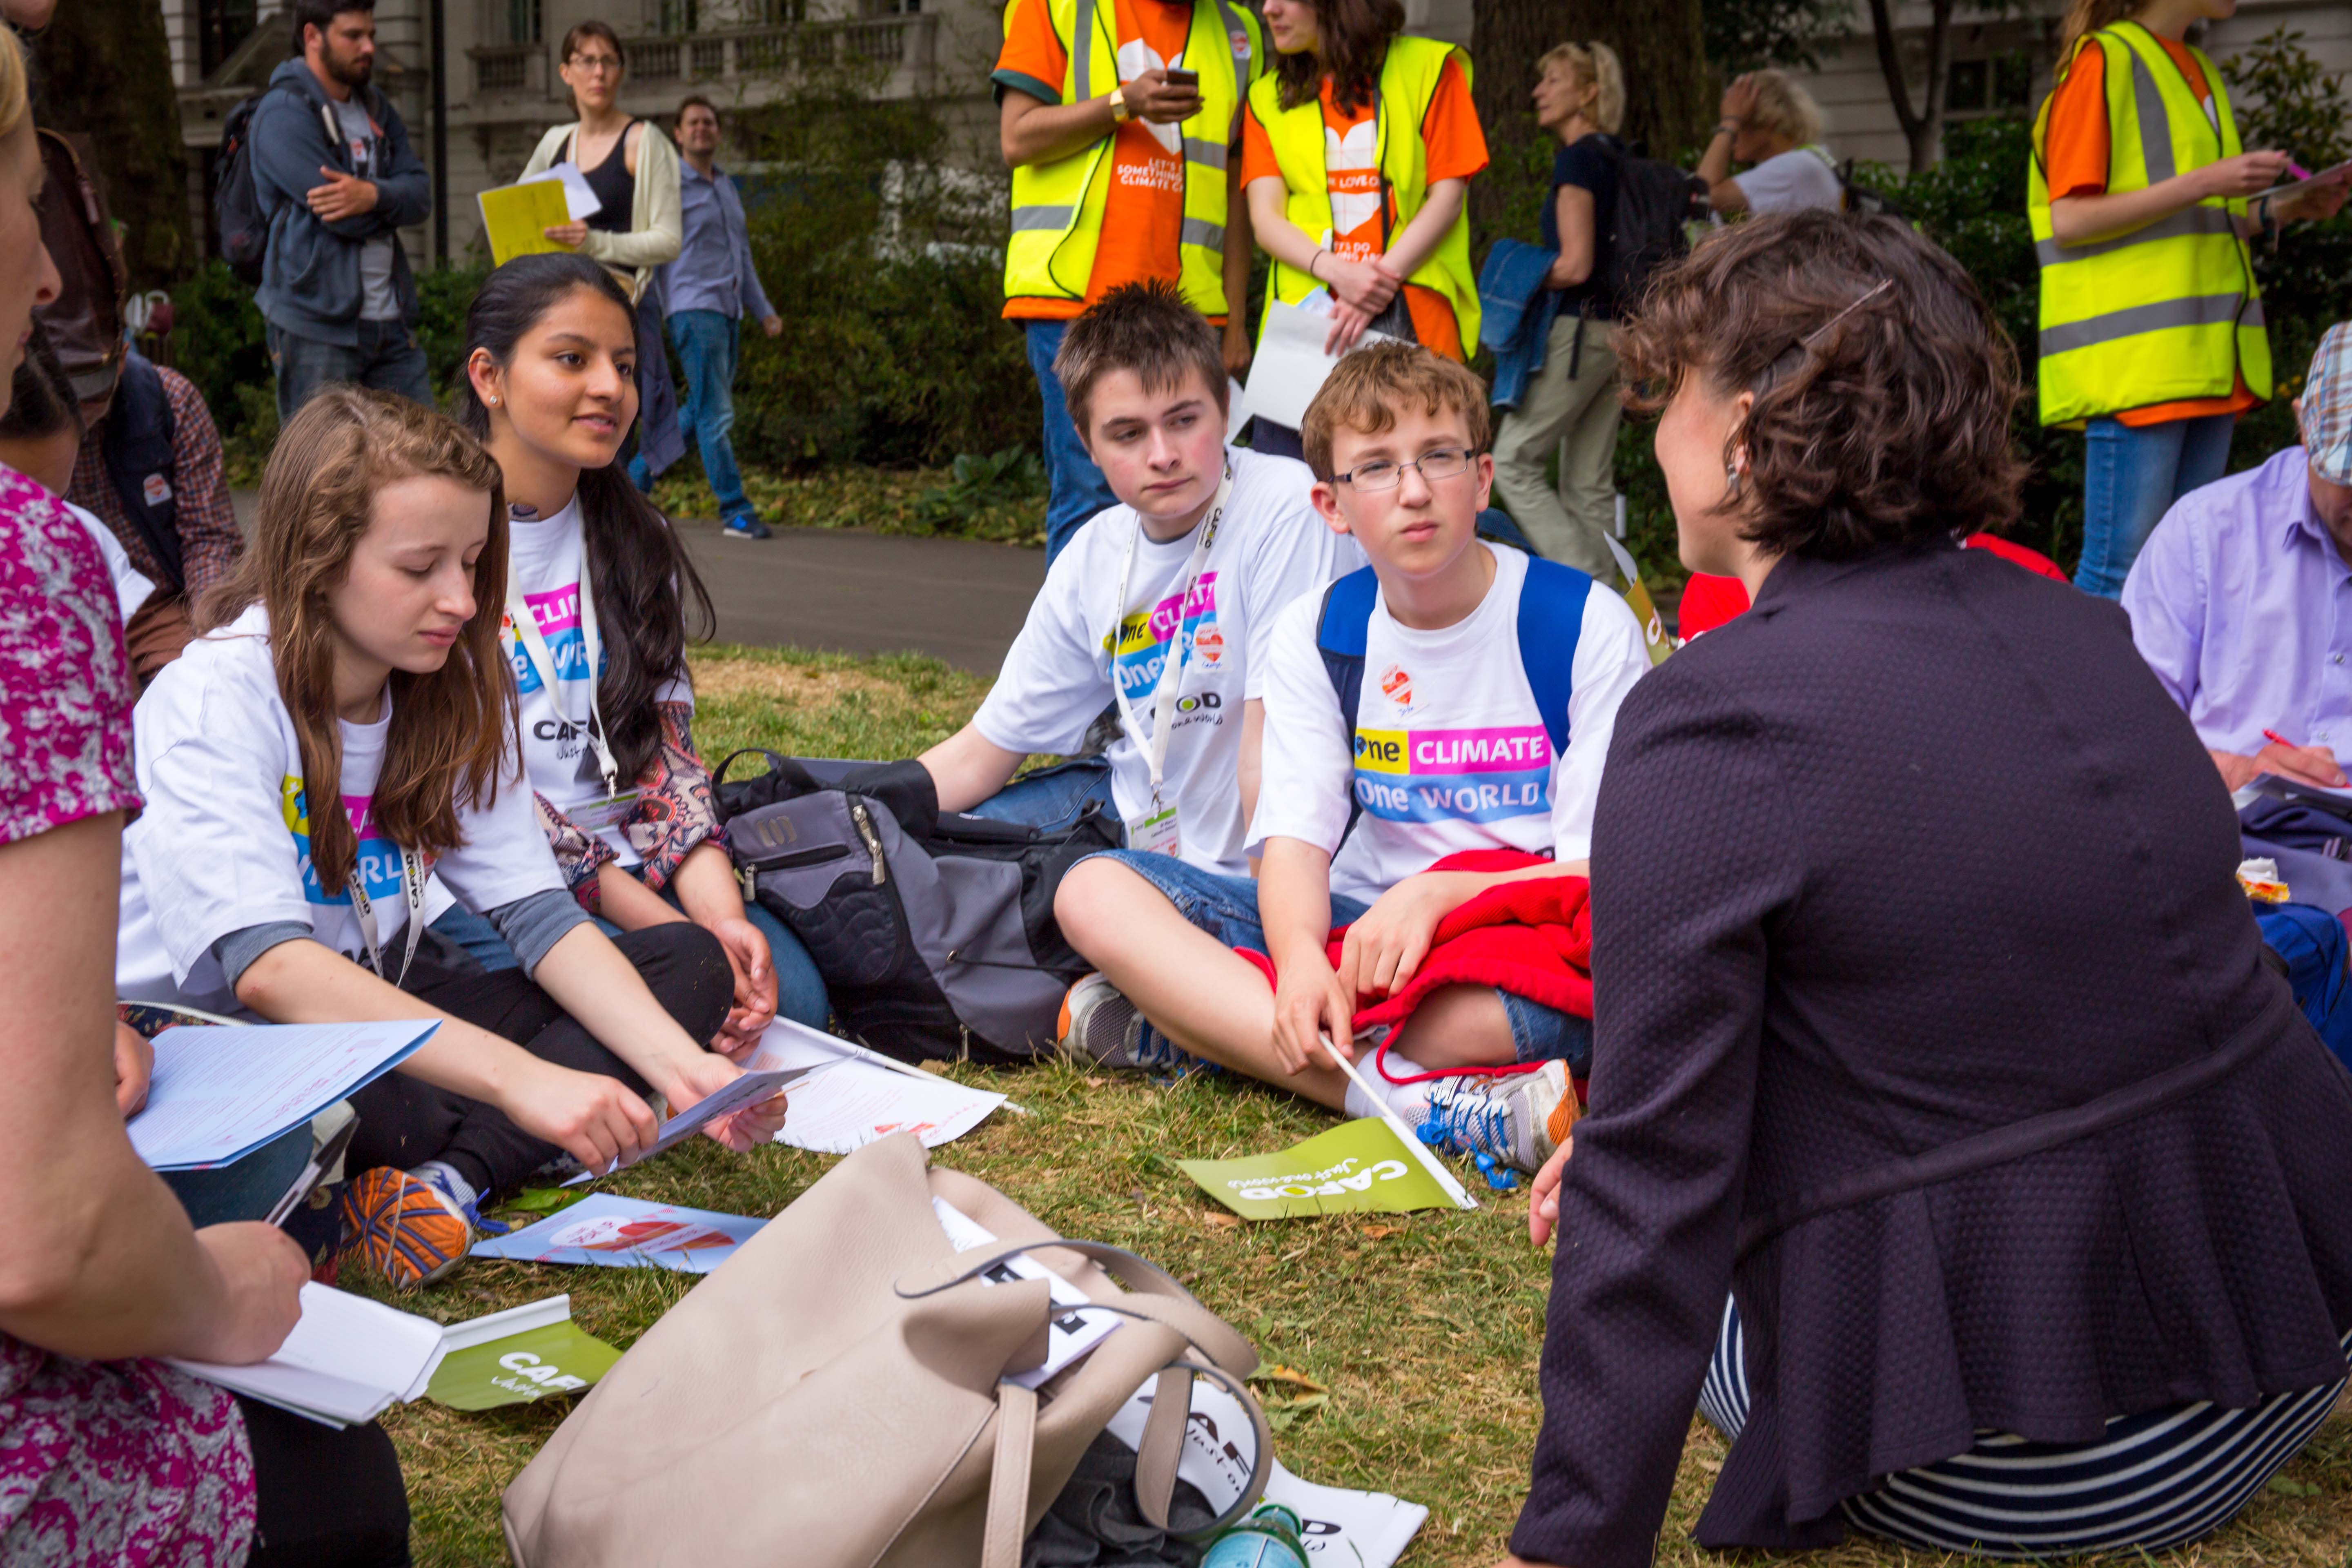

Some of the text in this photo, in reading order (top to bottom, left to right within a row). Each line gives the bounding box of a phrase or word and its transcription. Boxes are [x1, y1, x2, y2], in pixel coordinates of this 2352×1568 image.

[1416, 735, 1544, 765] CLIMATE
[1355, 777, 1540, 814] One WORLD
[1239, 1159, 1408, 1200] CAFOD
